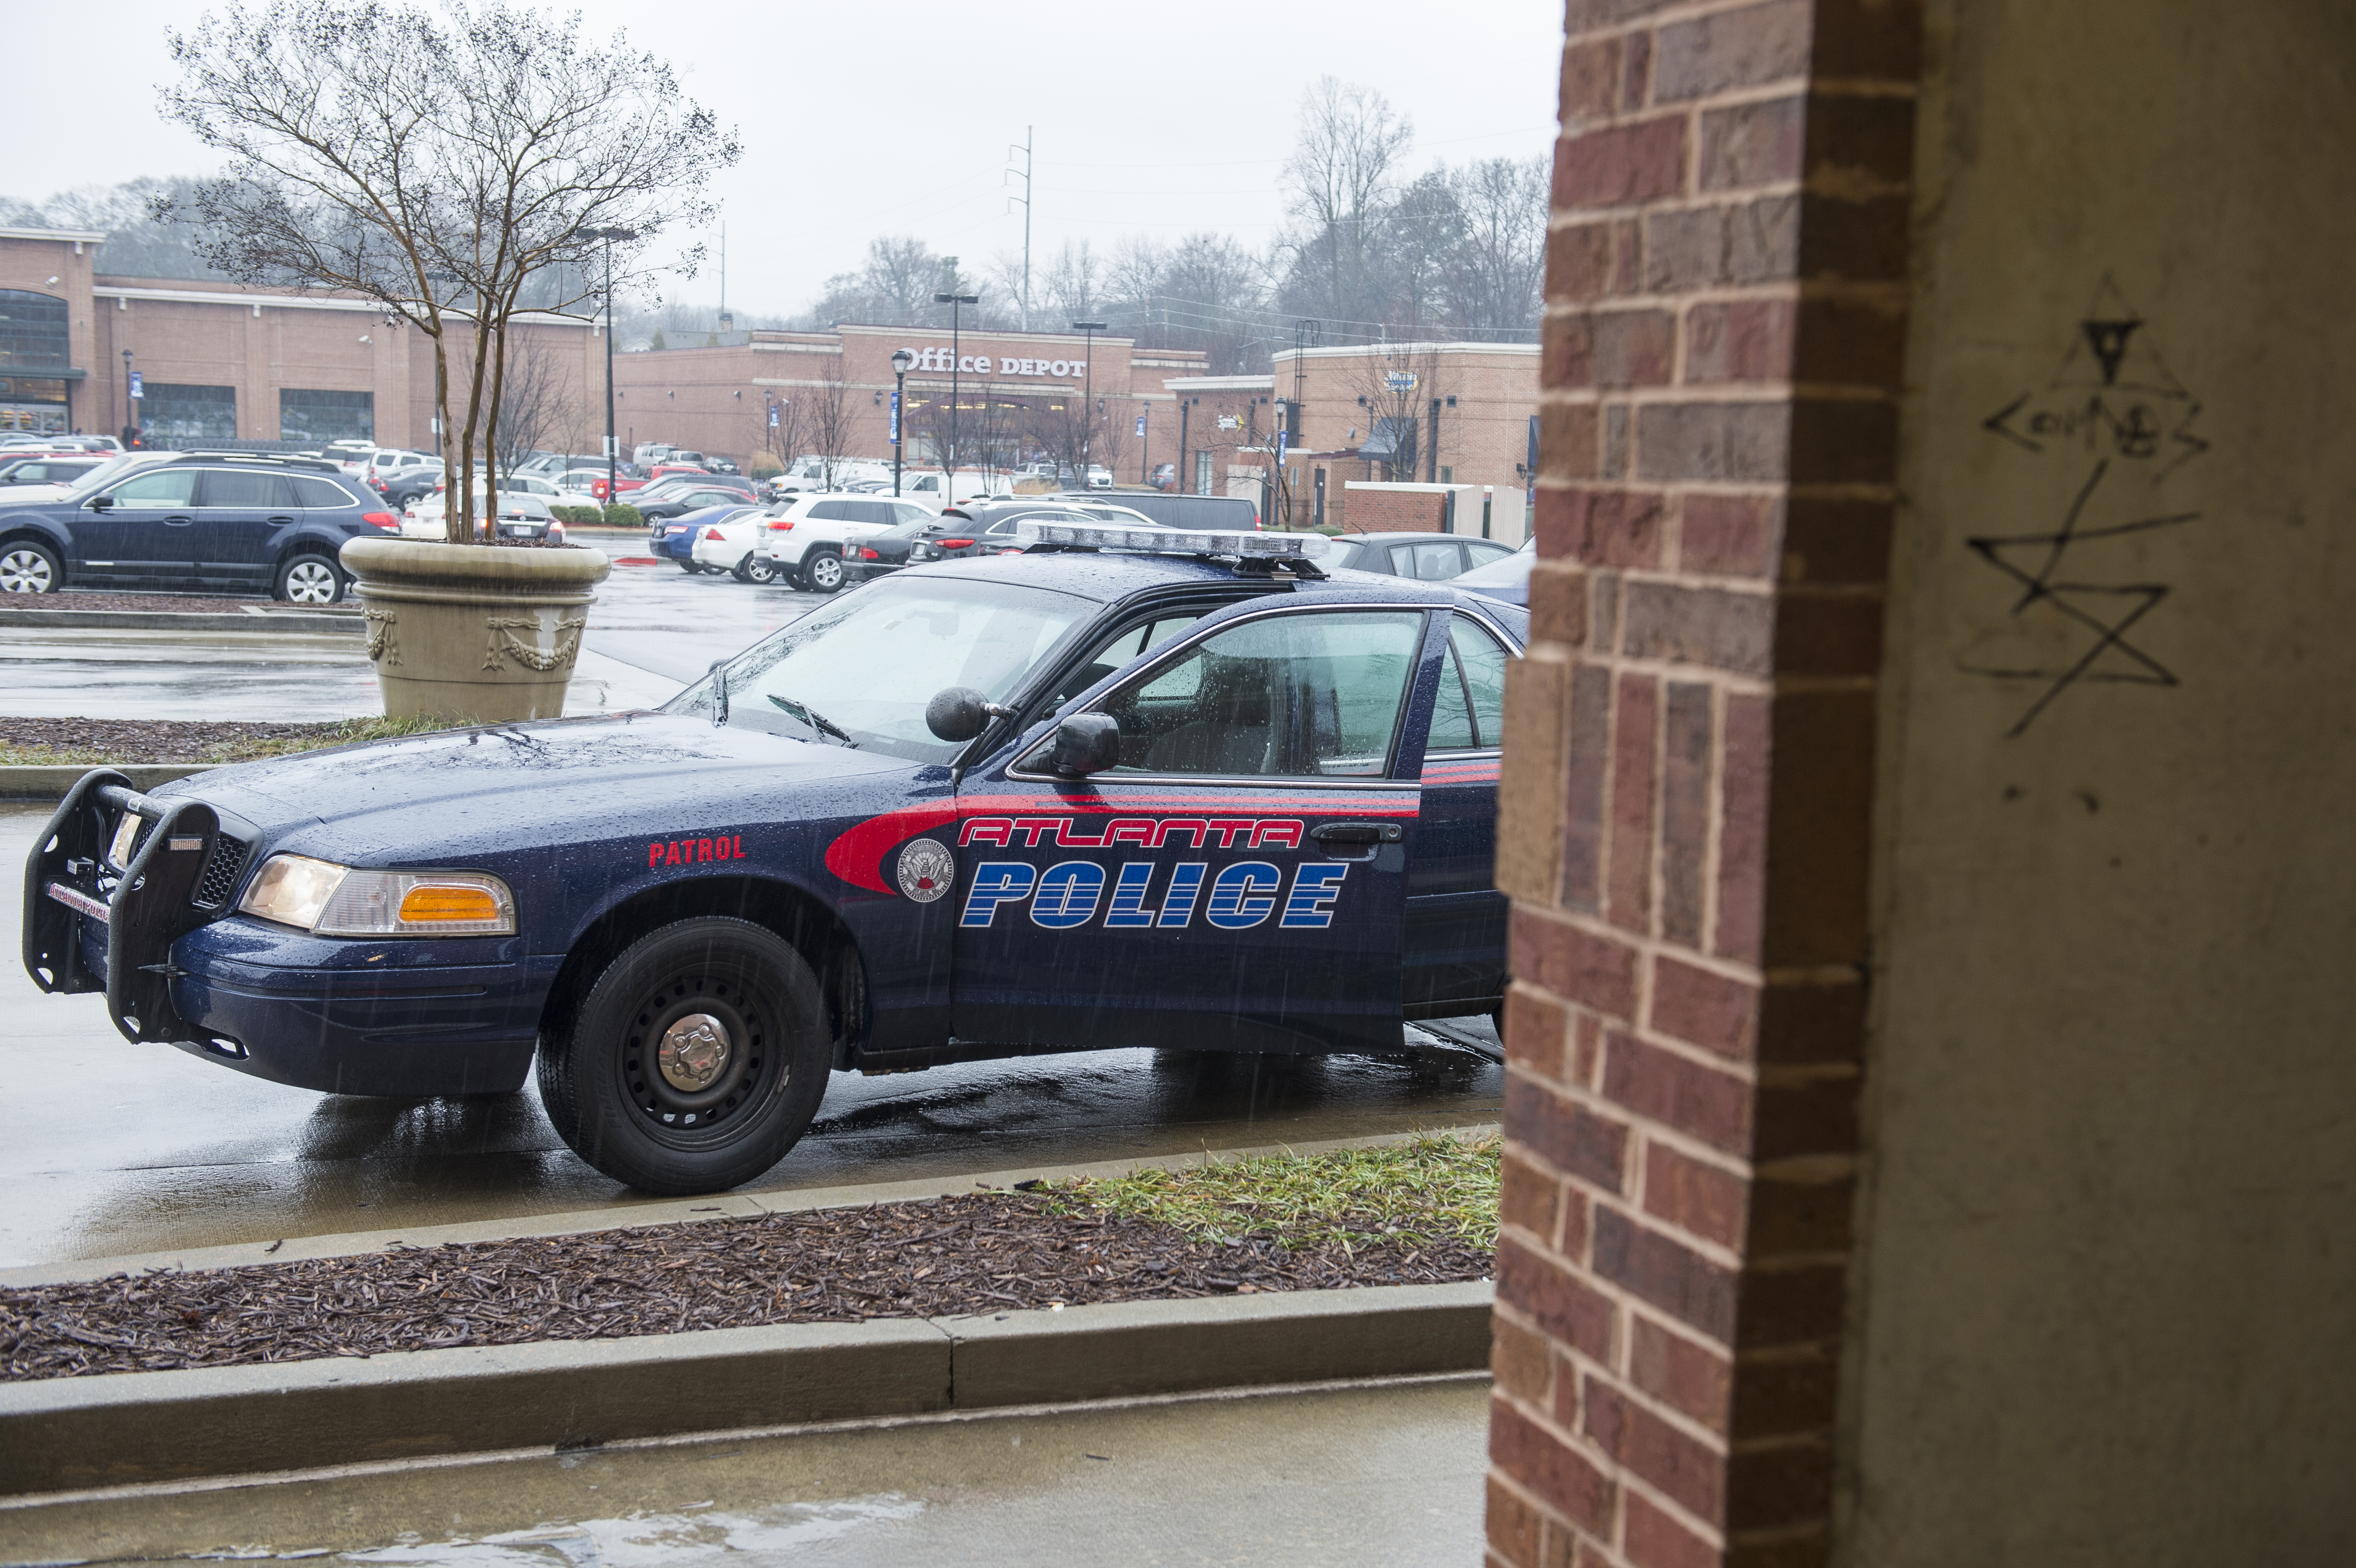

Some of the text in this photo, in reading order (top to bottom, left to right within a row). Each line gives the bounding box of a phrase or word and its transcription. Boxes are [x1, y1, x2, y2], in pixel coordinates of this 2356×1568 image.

[897, 347, 1086, 377] Office DEPOT
[958, 818, 1304, 848] ATLANTA
[649, 835, 746, 867] PATROL
[49, 883, 110, 923] ATLANTA POLIC
[959, 861, 1350, 929] POLICE
